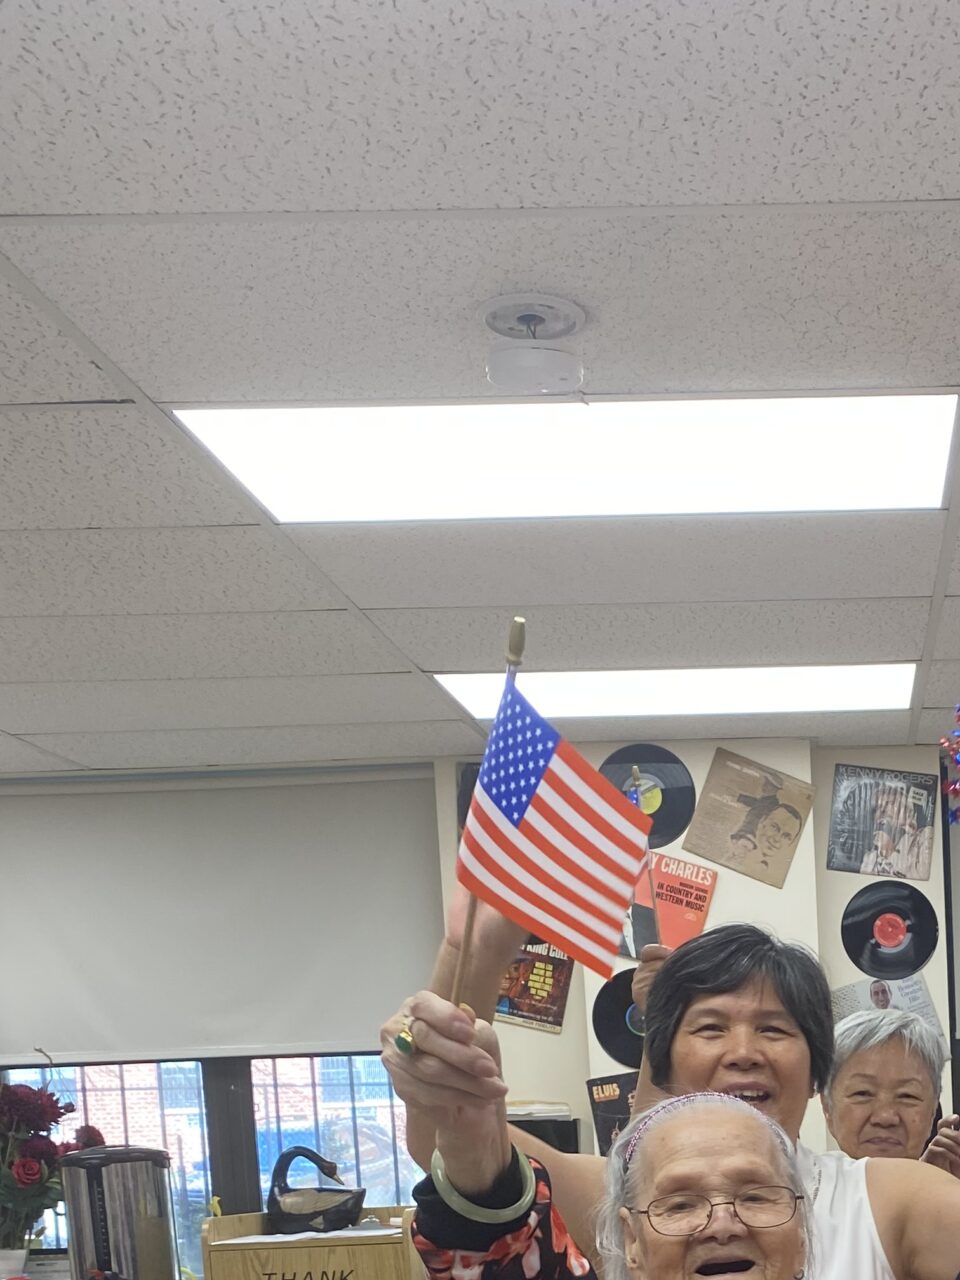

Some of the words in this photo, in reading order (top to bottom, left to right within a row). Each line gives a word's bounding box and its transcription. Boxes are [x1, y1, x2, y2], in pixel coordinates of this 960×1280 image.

[840, 766, 880, 780] KENNY
[884, 771, 934, 785] ROGERS
[661, 857, 713, 886] CHARLES
[656, 892, 683, 906] WESTERN
[684, 899, 705, 912] MUSIC
[657, 882, 665, 890] IN
[665, 885, 693, 899] COUNTRY
[694, 892, 707, 903] AND
[592, 1083, 620, 1101] ELVIS
